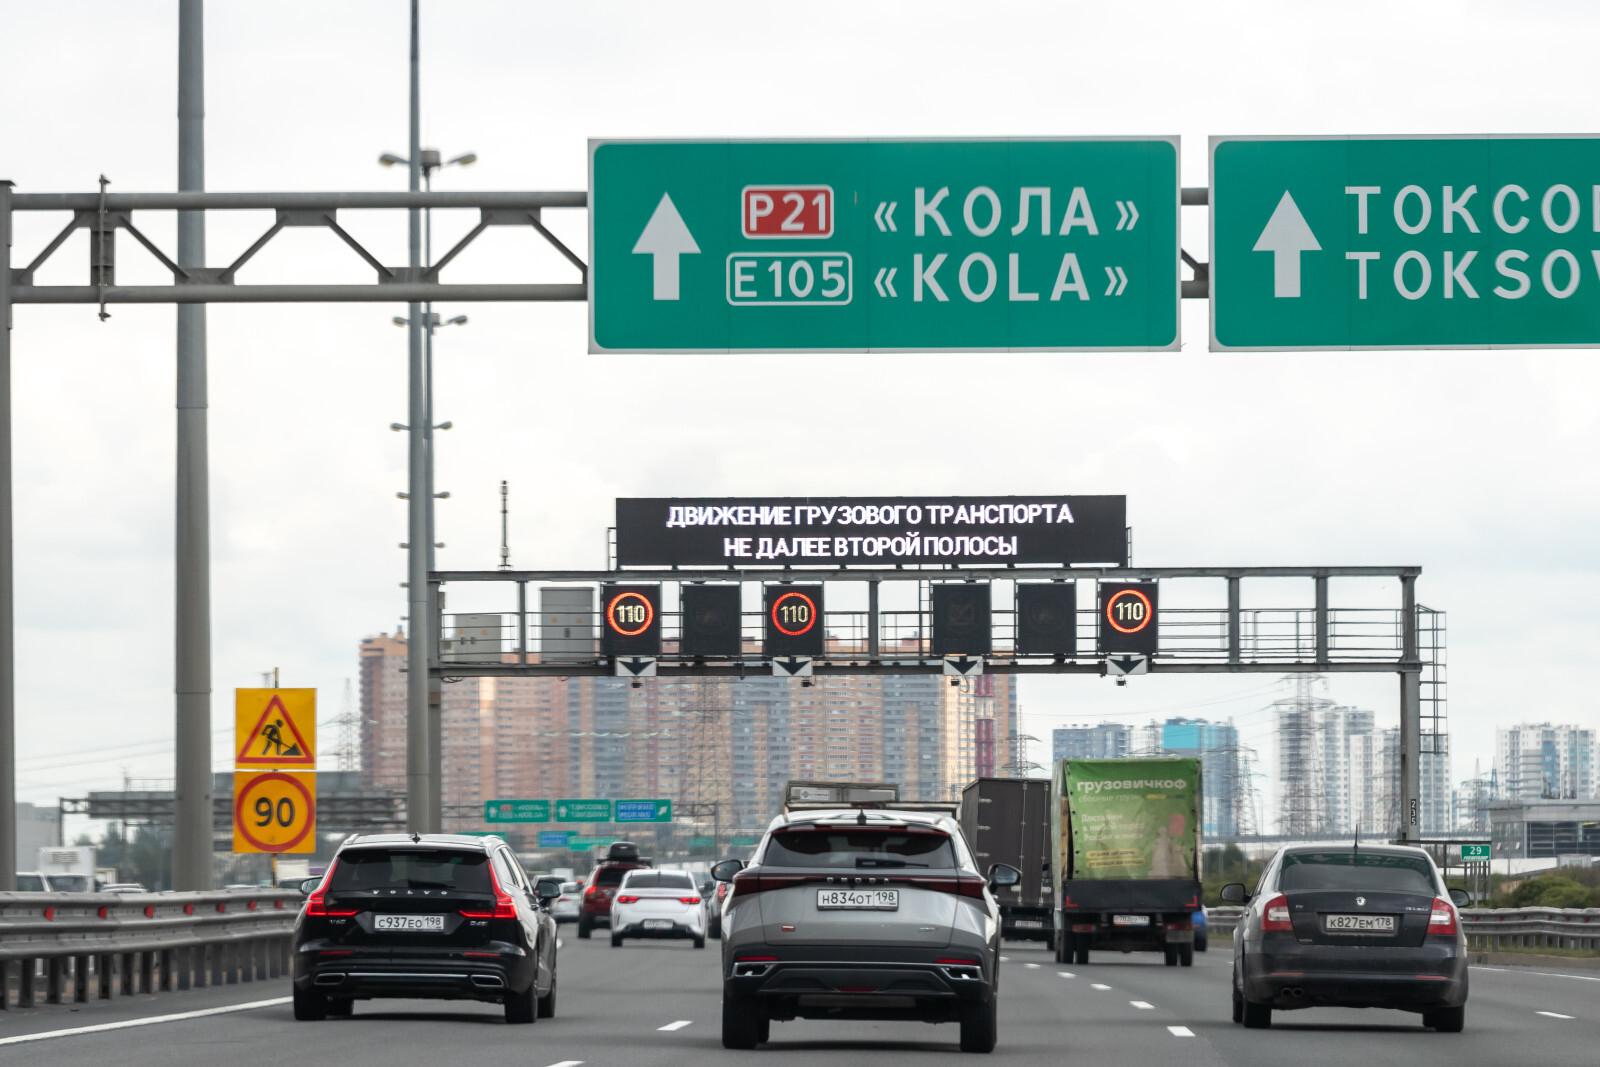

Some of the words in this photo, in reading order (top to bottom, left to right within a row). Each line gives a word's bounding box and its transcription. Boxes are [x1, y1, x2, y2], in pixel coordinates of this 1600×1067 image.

[1344, 184, 1600, 235] ТОКСО
[1345, 249, 1600, 300] TOKSO
[666, 506, 792, 528] ДВИЖЕНИЕ
[795, 505, 922, 525] ГРУЗОВОГО
[925, 504, 1074, 524] ТРАНСПОРТА
[724, 538, 752, 556] НЕ
[755, 537, 831, 559] ДАЛЕЕ
[834, 532, 920, 556] ВТОРОЙ
[923, 536, 1018, 555] ПОЛОСЫ
[616, 605, 645, 623] 110
[780, 604, 808, 623] 110
[1115, 602, 1143, 621] 110
[1077, 779, 1186, 794] грузовичкоф
[255, 797, 294, 828] 90
[1470, 846, 1482, 855] 29
